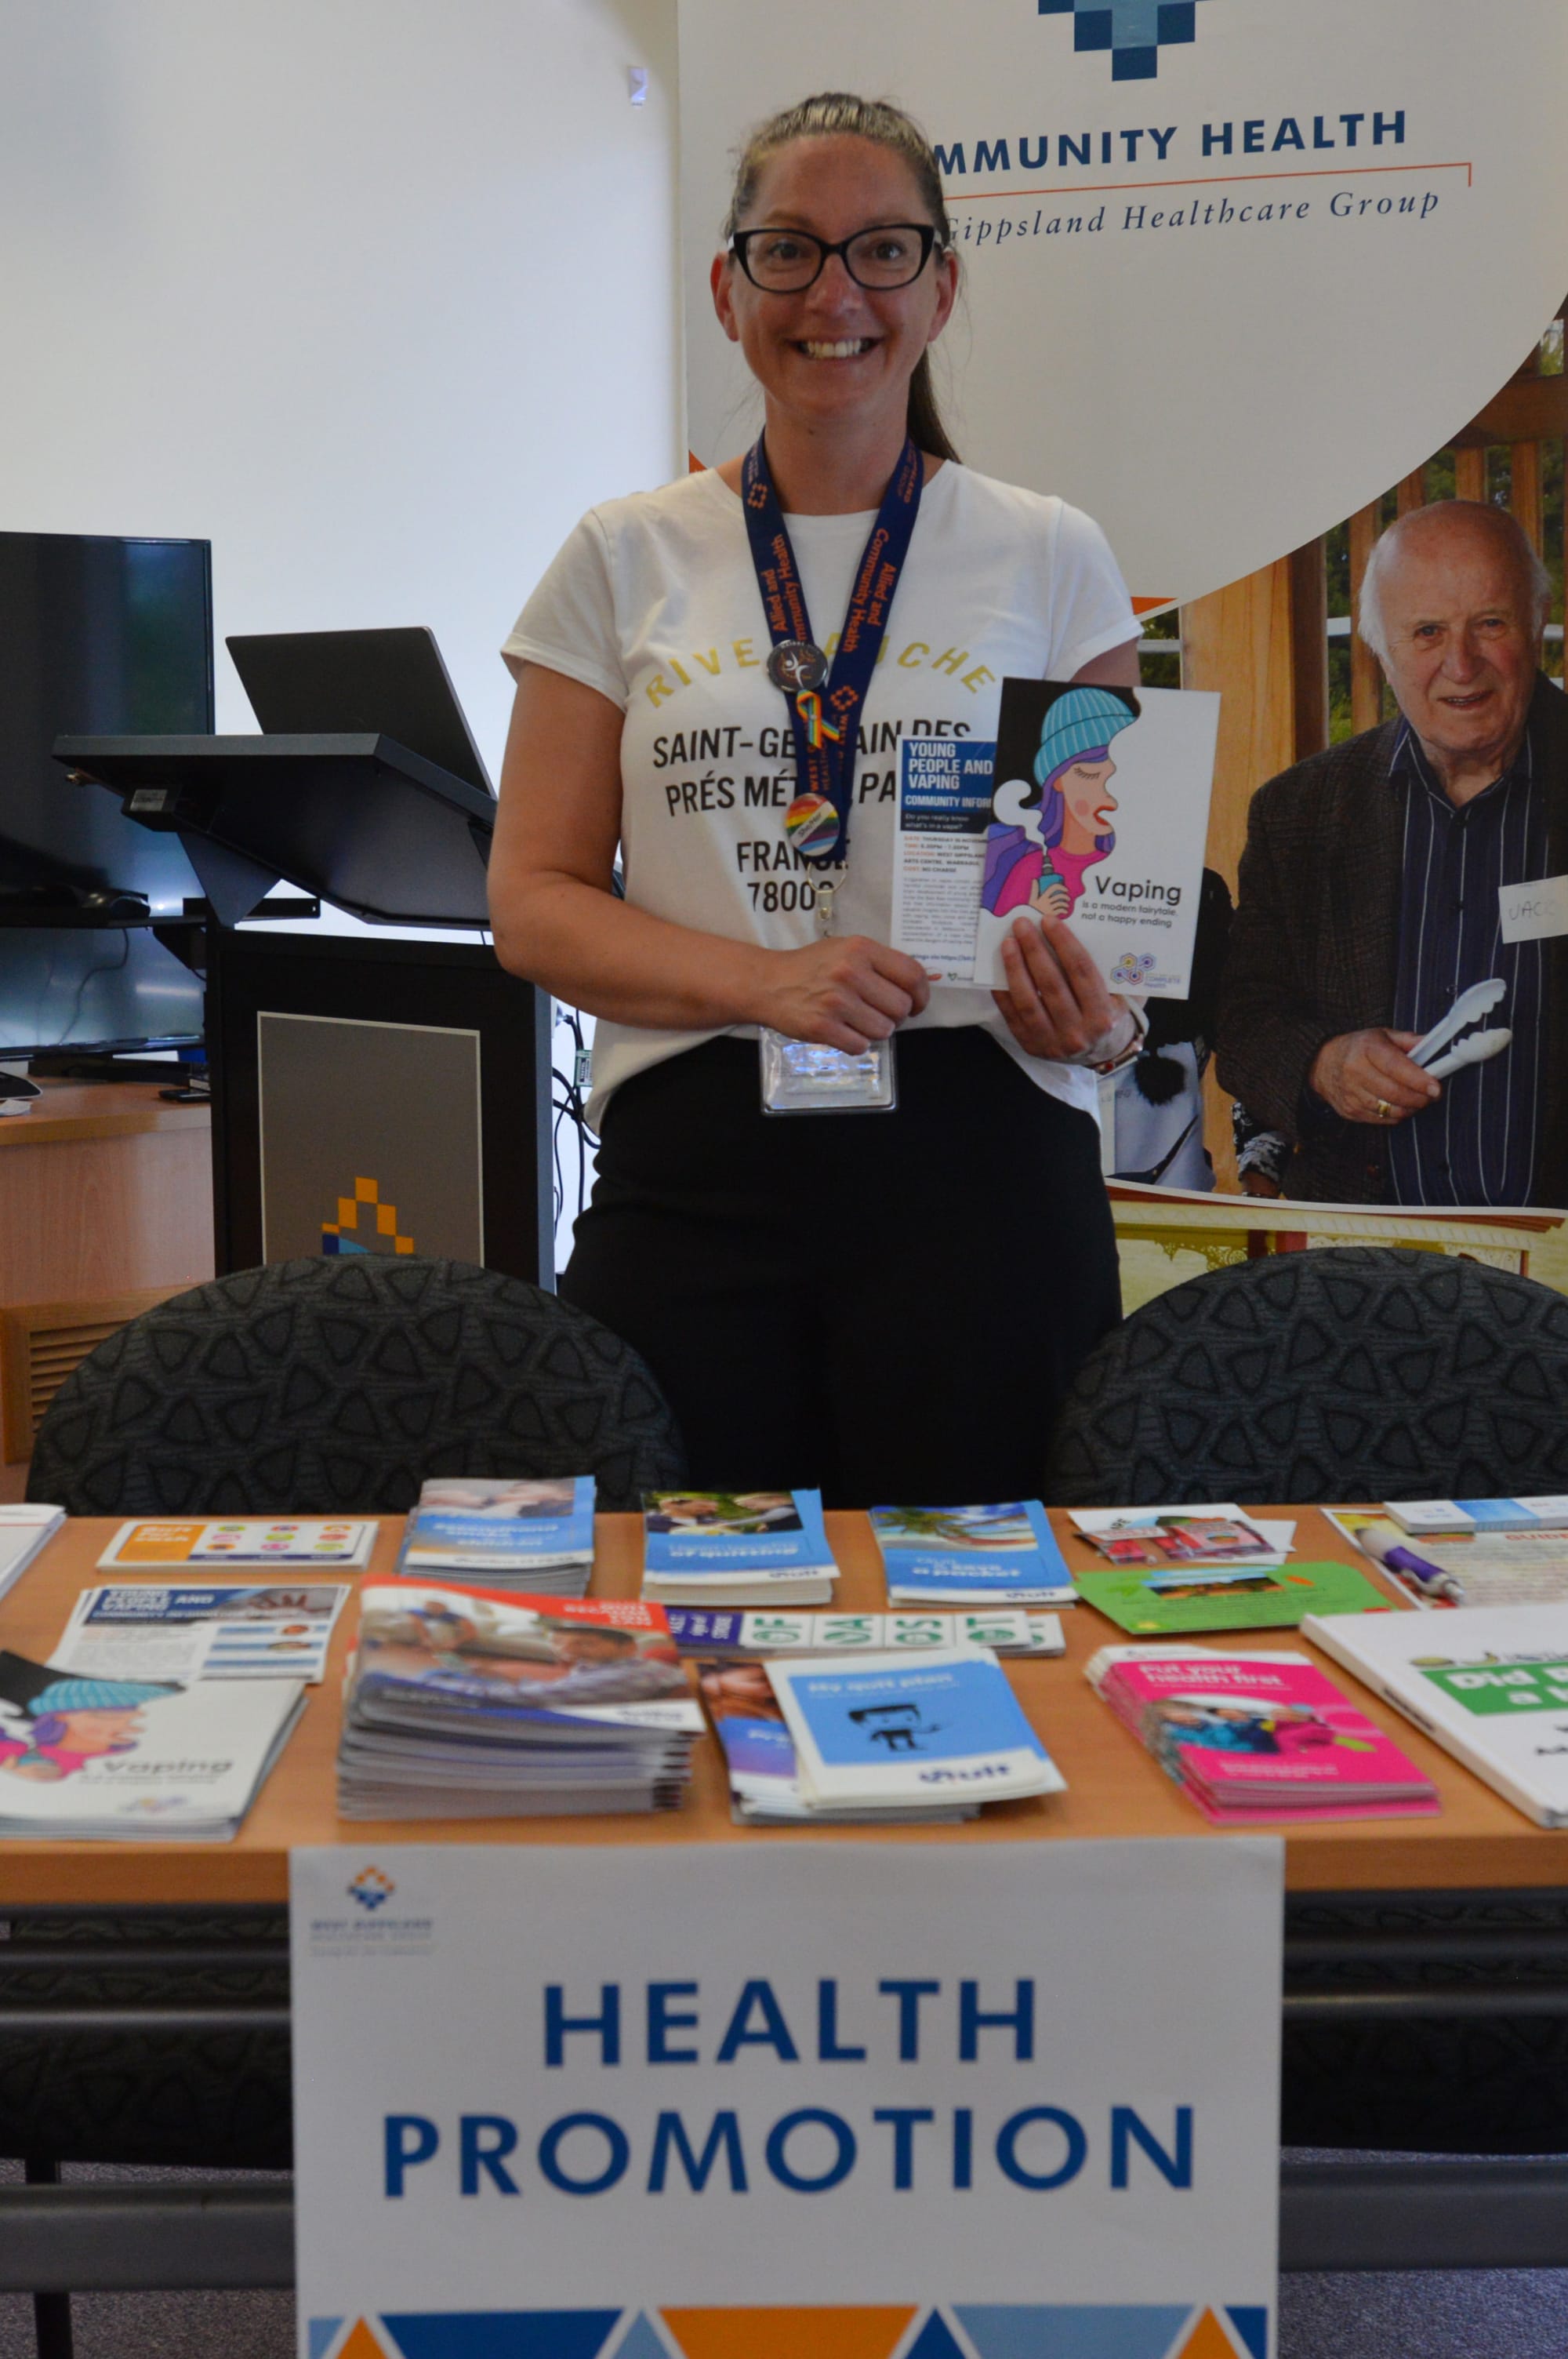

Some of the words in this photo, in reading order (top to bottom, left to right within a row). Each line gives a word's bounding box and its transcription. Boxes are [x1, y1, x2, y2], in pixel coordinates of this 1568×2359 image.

[934, 126, 1178, 175] MMUNITY
[1202, 110, 1406, 156] HEALTH
[1121, 195, 1310, 231] Healthcare
[1330, 189, 1440, 219] Group
[851, 528, 890, 605] Community
[874, 562, 898, 602] Allied
[785, 581, 808, 641] mmunity
[842, 609, 867, 652] Health
[644, 638, 760, 709] RIVE
[908, 758, 961, 774] PEOPLE
[964, 759, 993, 775] AND
[909, 742, 956, 758] YOUNG
[665, 771, 735, 817] PRÉS
[905, 794, 960, 808] COMMUNITY
[908, 773, 960, 790] VAPING
[1095, 875, 1181, 906] Vaping
[1101, 902, 1137, 912] modern
[1107, 914, 1137, 925] happy
[1139, 918, 1173, 929] ending
[174, 1594, 215, 1605] AND
[104, 1758, 233, 1776] Vaping
[544, 1978, 1035, 2067] HEALTH
[384, 2105, 1193, 2198] PROMOTION
